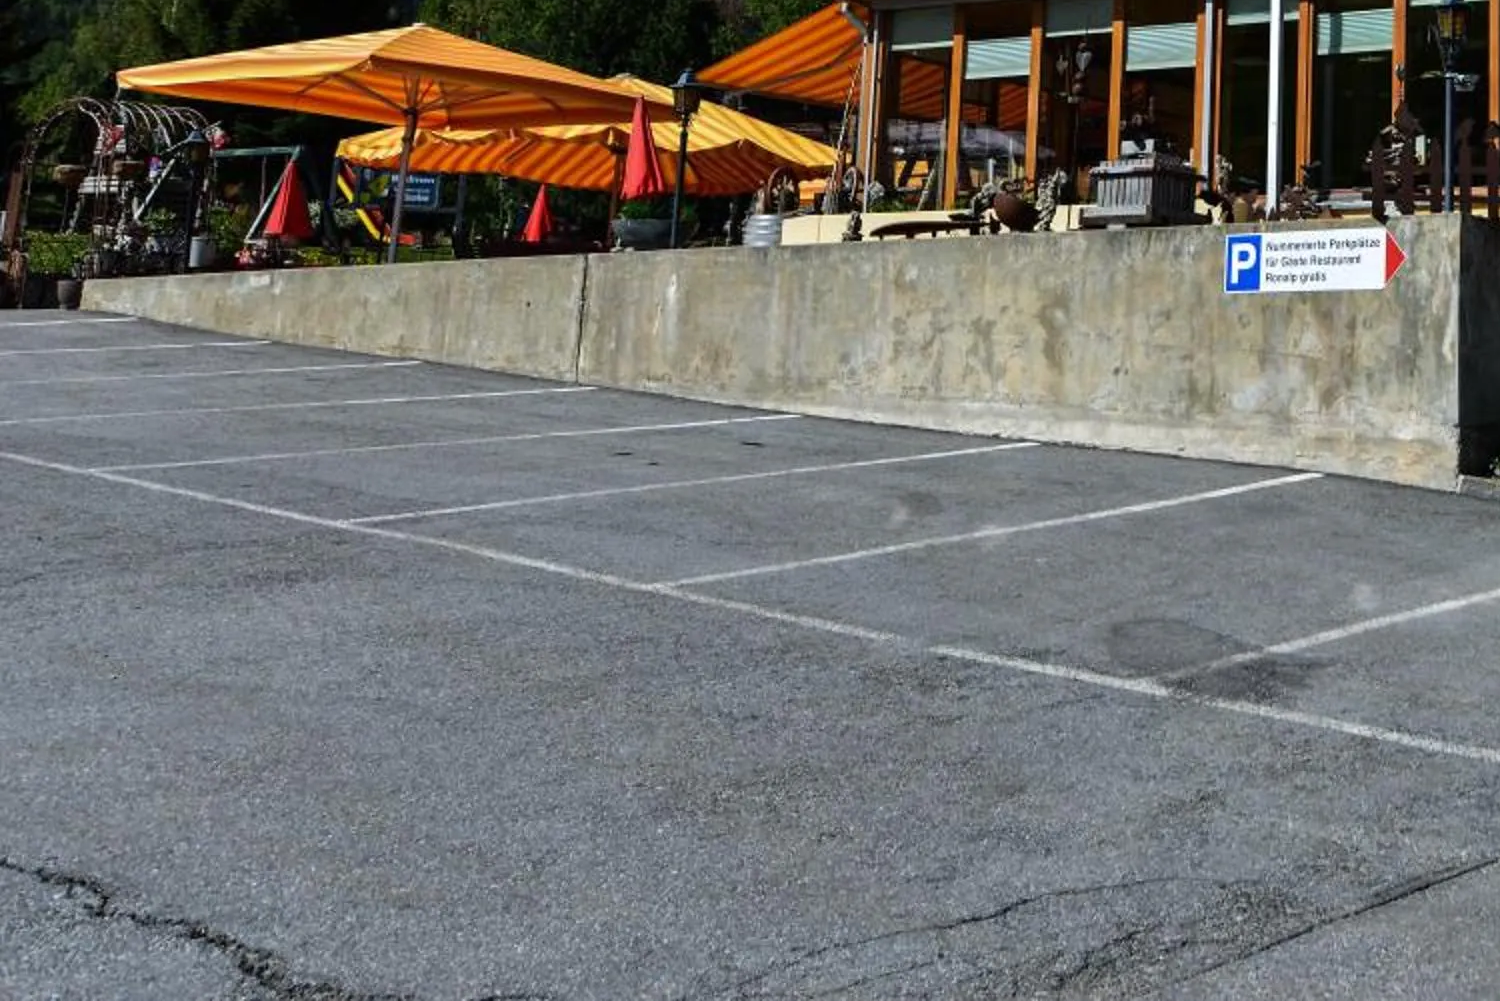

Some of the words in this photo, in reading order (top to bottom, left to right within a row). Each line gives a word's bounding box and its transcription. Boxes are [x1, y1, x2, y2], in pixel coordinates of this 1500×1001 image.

[1265, 240, 1327, 252] Nummerierte
[1329, 237, 1381, 251] Parkplätze
[1231, 242, 1257, 285] P
[1265, 256, 1278, 268] für
[1309, 254, 1361, 266] Restaurant
[1265, 272, 1297, 285] Ronalp
[1299, 271, 1327, 284] gratis
